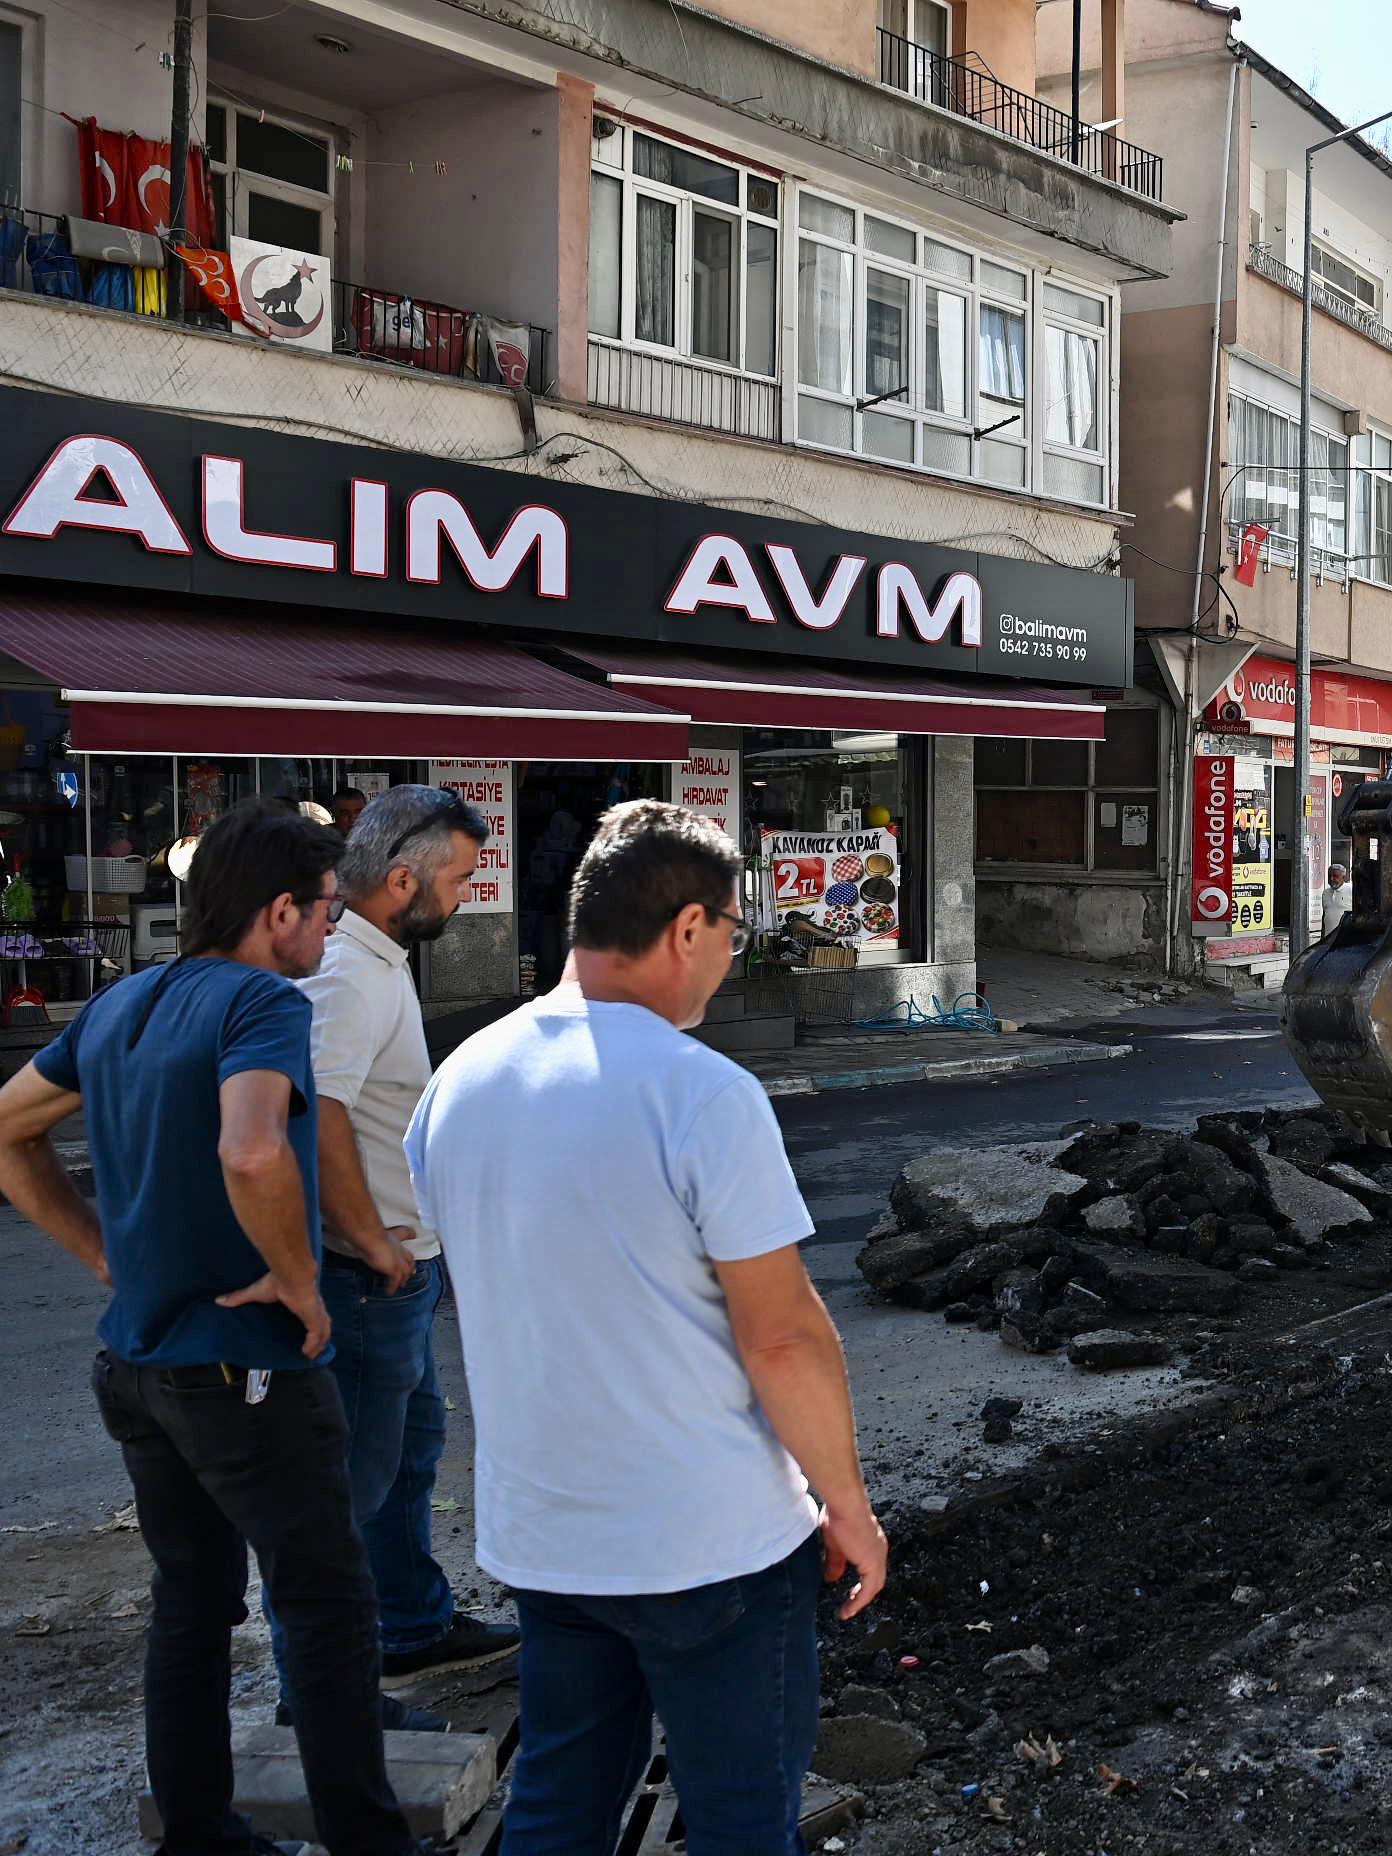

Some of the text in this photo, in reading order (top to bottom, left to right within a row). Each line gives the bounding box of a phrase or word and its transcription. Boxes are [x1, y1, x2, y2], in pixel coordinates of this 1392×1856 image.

[2, 433, 983, 648] ALIM AVM
[1015, 616, 1087, 642] balimavm
[999, 638, 1087, 661] 0542 735 90 99
[1250, 677, 1297, 706] vodafo
[1211, 723, 1249, 734] vodafone
[681, 756, 730, 776] AMBALAJ
[682, 787, 729, 806] HIRDAVAT
[1205, 760, 1226, 878] vodafone
[475, 843, 509, 869] STİLİ
[772, 836, 834, 854] KAVANOZ
[469, 875, 499, 902] TERİ
